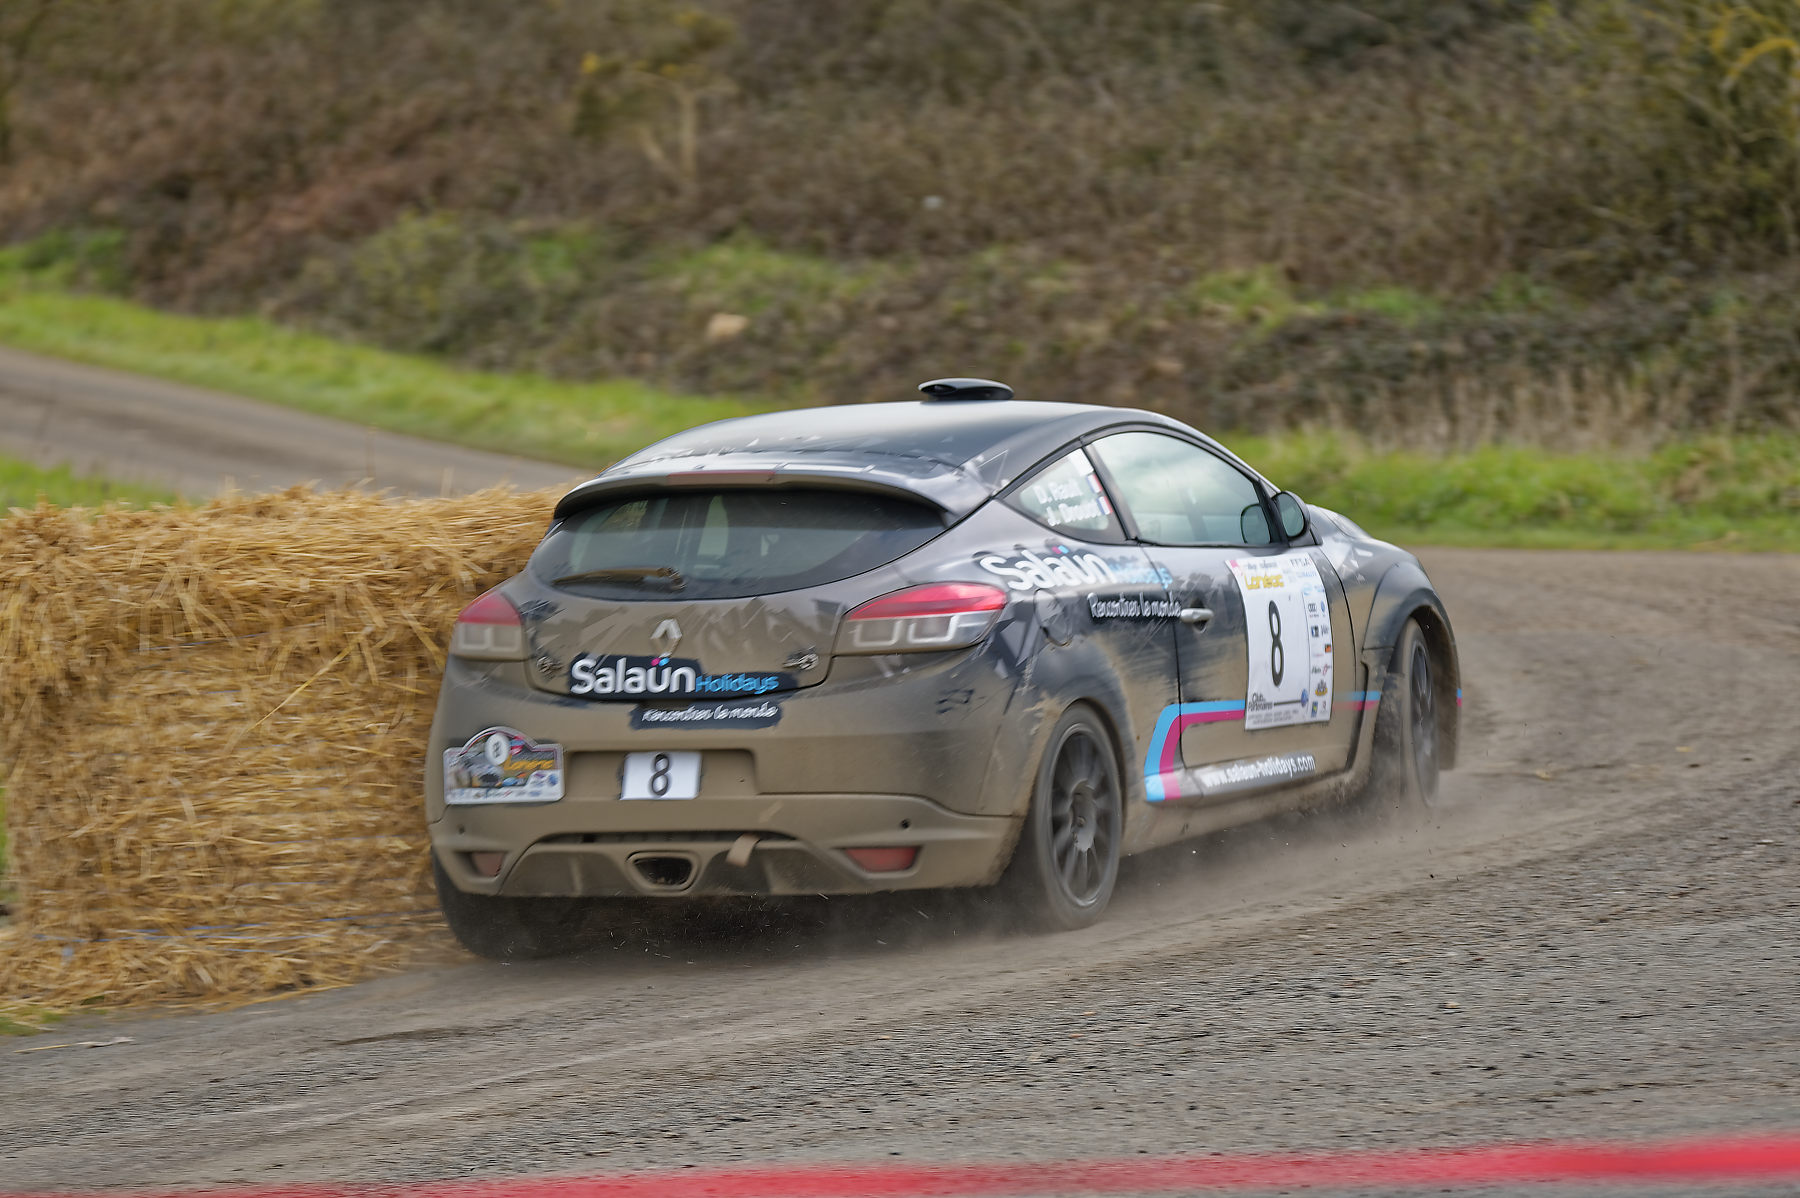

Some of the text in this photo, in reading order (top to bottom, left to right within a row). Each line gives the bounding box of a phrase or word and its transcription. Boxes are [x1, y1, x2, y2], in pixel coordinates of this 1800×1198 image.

[980, 545, 1118, 591] Salaün
[1139, 591, 1152, 617] le
[1151, 590, 1181, 617] monde
[1268, 600, 1285, 688] 8
[570, 656, 780, 695] Salaün Holidays
[713, 704, 731, 720] le
[729, 701, 779, 719] monde
[649, 753, 671, 797] 8
